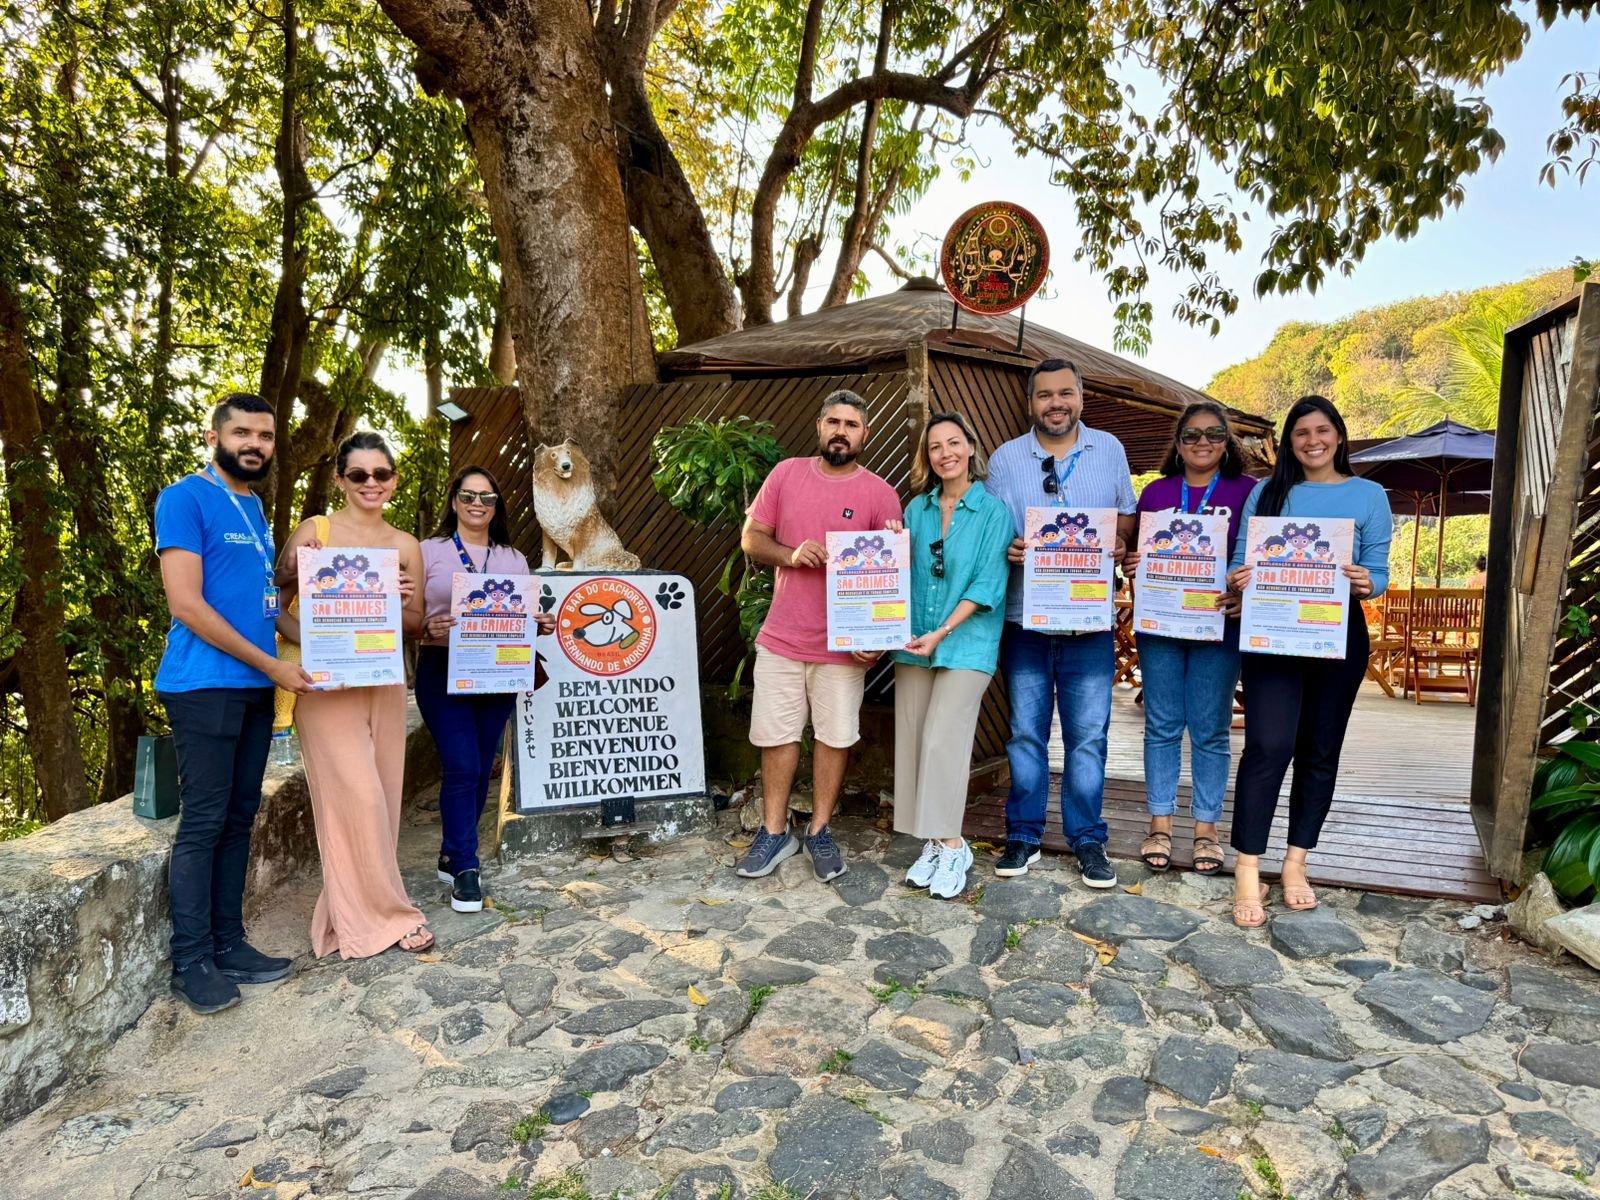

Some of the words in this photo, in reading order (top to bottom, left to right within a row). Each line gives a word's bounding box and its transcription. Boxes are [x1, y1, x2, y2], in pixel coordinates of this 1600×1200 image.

[1034, 553, 1052, 567] SÃO
[1054, 553, 1103, 567] CRIMES!
[1146, 559, 1164, 573] SÃO
[1167, 560, 1216, 577] CRIMES!
[836, 576, 853, 590] SÃO
[855, 574, 899, 589] CRIMES!
[1256, 568, 1277, 583] SÃO
[1280, 569, 1336, 586] CRIMES!
[312, 600, 331, 616] SÃO
[334, 600, 387, 616] CRIMES!
[565, 592, 585, 613] BAR
[585, 583, 599, 596] DO
[602, 582, 648, 614] CACHORRO
[461, 618, 478, 632] SÃO
[481, 618, 526, 633] CRIMES!
[563, 634, 604, 671] FERNANDO
[607, 661, 620, 672] DE
[623, 627, 653, 667] NORONHA
[558, 676, 675, 698] BEM-VINDO
[555, 697, 659, 718] WELCOME
[552, 715, 668, 738] BIENVENUE
[550, 734, 677, 759] BENVENUTO
[549, 754, 679, 779] BIENVENIDO
[543, 772, 682, 800] WILLKOMMEN
